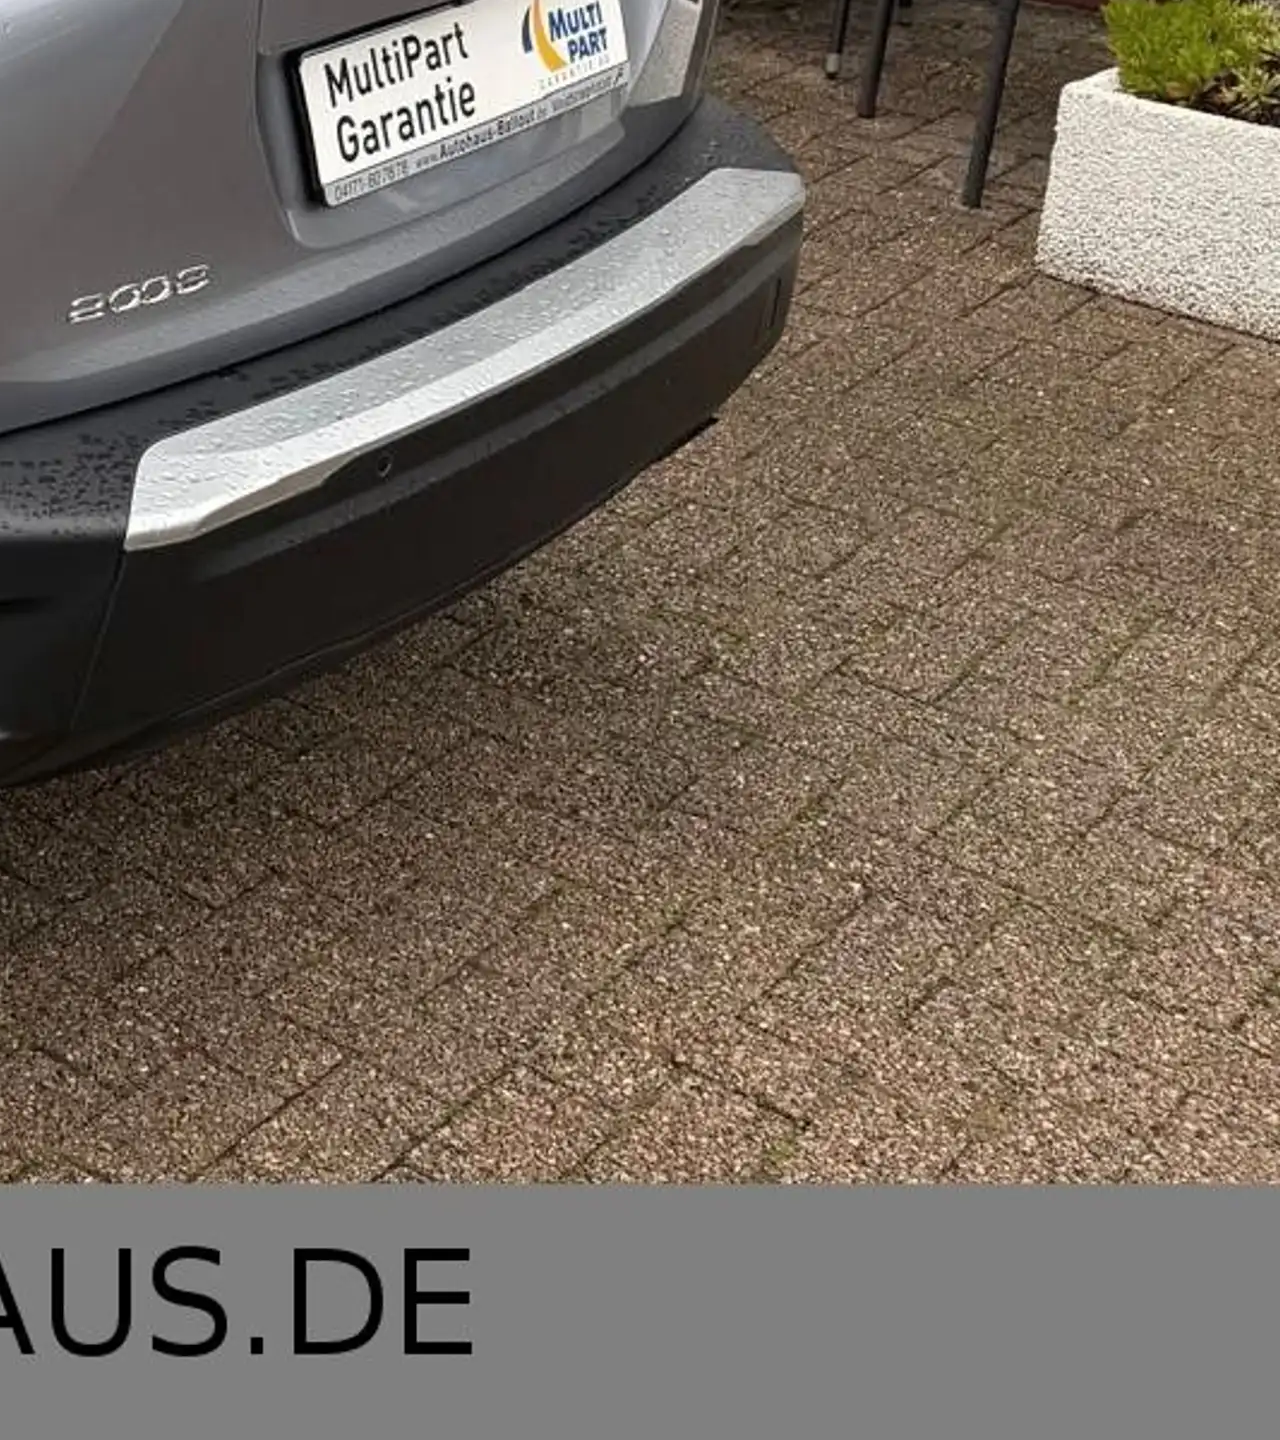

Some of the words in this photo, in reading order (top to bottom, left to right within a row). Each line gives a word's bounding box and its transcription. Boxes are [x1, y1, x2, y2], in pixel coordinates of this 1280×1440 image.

[547, 0, 603, 43] MULTI
[567, 26, 608, 64] PART
[324, 21, 470, 109] MultiPart
[336, 76, 477, 163] Garantie
[67, 263, 211, 325] 2008
